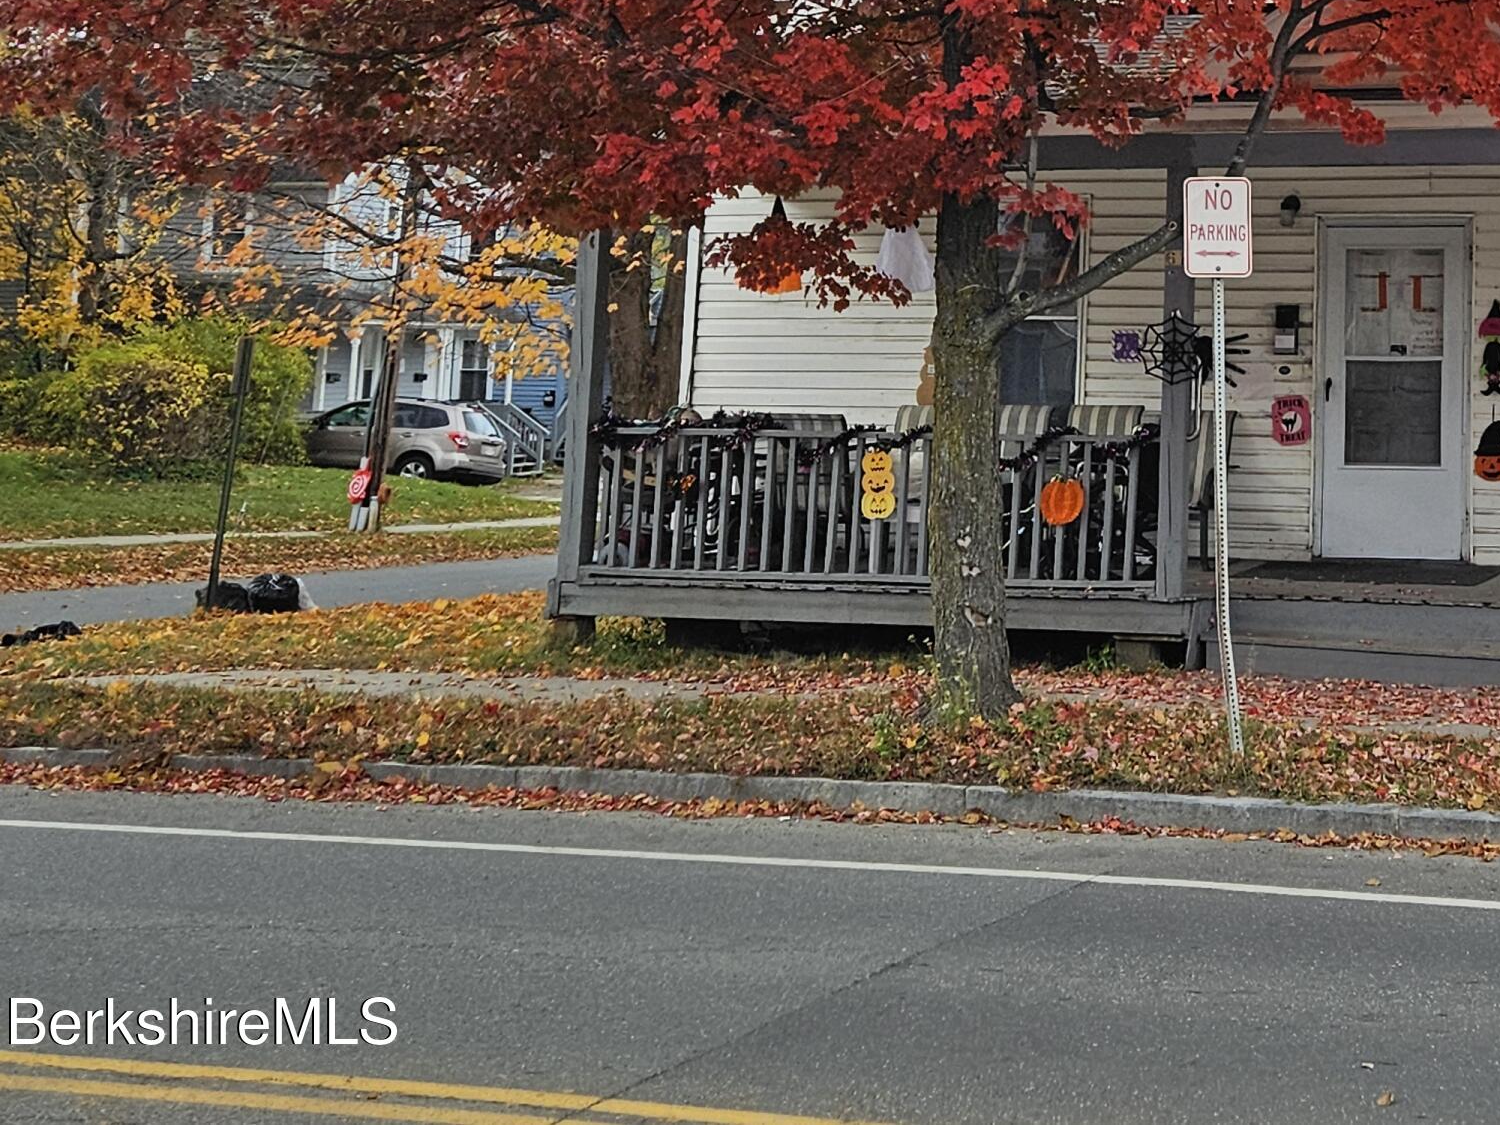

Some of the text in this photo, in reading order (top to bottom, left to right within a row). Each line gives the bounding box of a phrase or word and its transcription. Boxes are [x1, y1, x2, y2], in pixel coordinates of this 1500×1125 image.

[1204, 189, 1233, 210] NO
[1190, 223, 1247, 242] PARKING
[1276, 398, 1304, 410] TRICK
